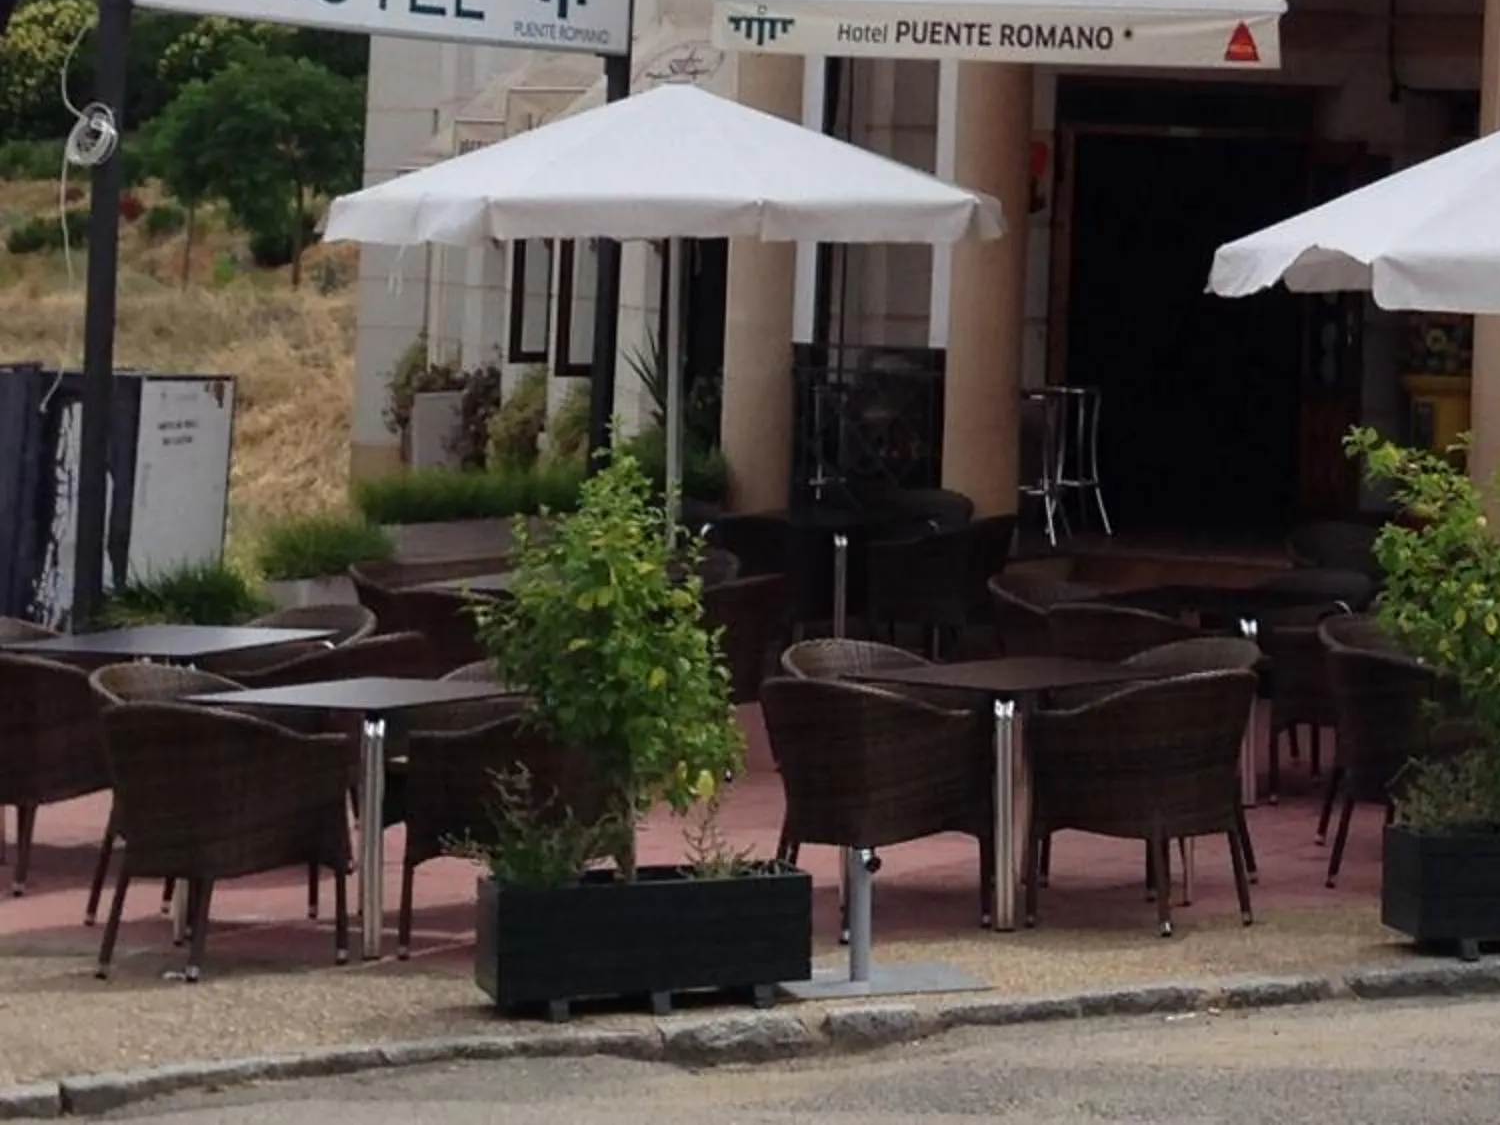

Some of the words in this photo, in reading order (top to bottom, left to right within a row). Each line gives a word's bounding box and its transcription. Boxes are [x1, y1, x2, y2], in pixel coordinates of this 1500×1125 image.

[837, 22, 888, 44] Hotel
[895, 21, 992, 47] PUENTE
[999, 23, 1114, 50] ROMANO
